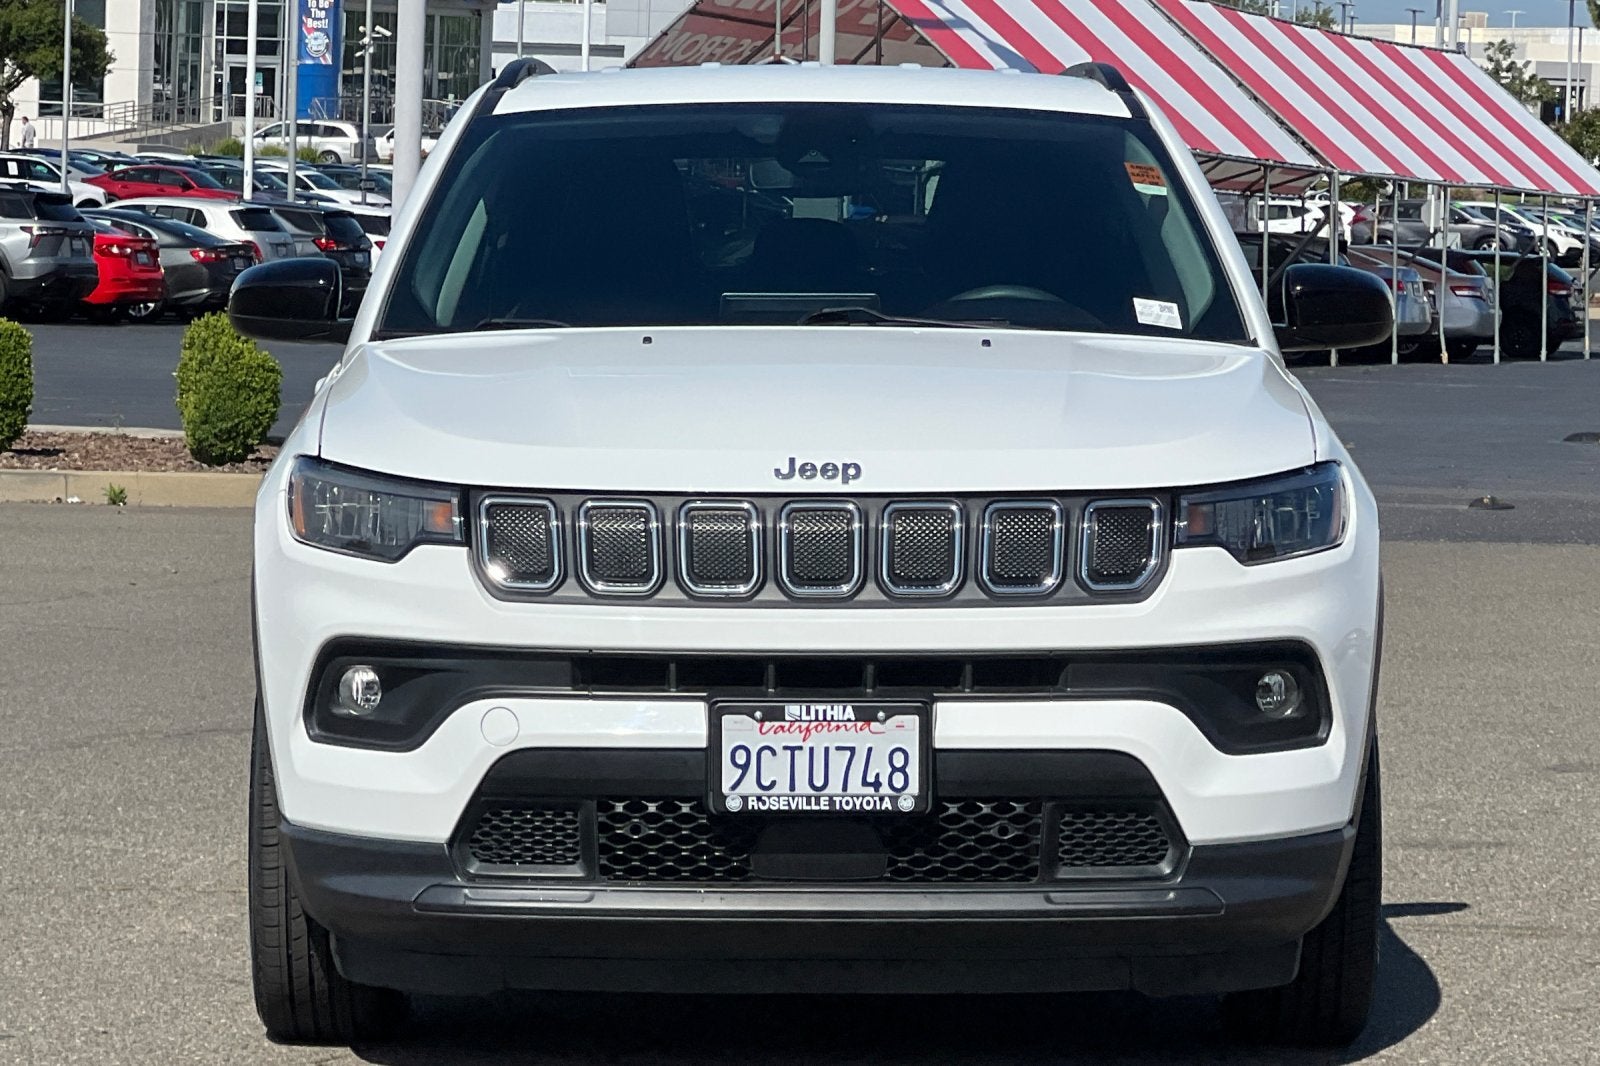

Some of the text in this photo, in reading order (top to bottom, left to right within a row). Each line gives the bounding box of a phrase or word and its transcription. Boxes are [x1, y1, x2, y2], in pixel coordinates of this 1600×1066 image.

[310, 8, 326, 18] The
[306, 17, 329, 28] Best!
[774, 457, 862, 485] Jeep
[801, 704, 855, 721] LITHIA
[758, 720, 886, 743] California
[729, 744, 910, 793] 9CTU748
[748, 796, 892, 811] ROSEVILLE TOYOTA
